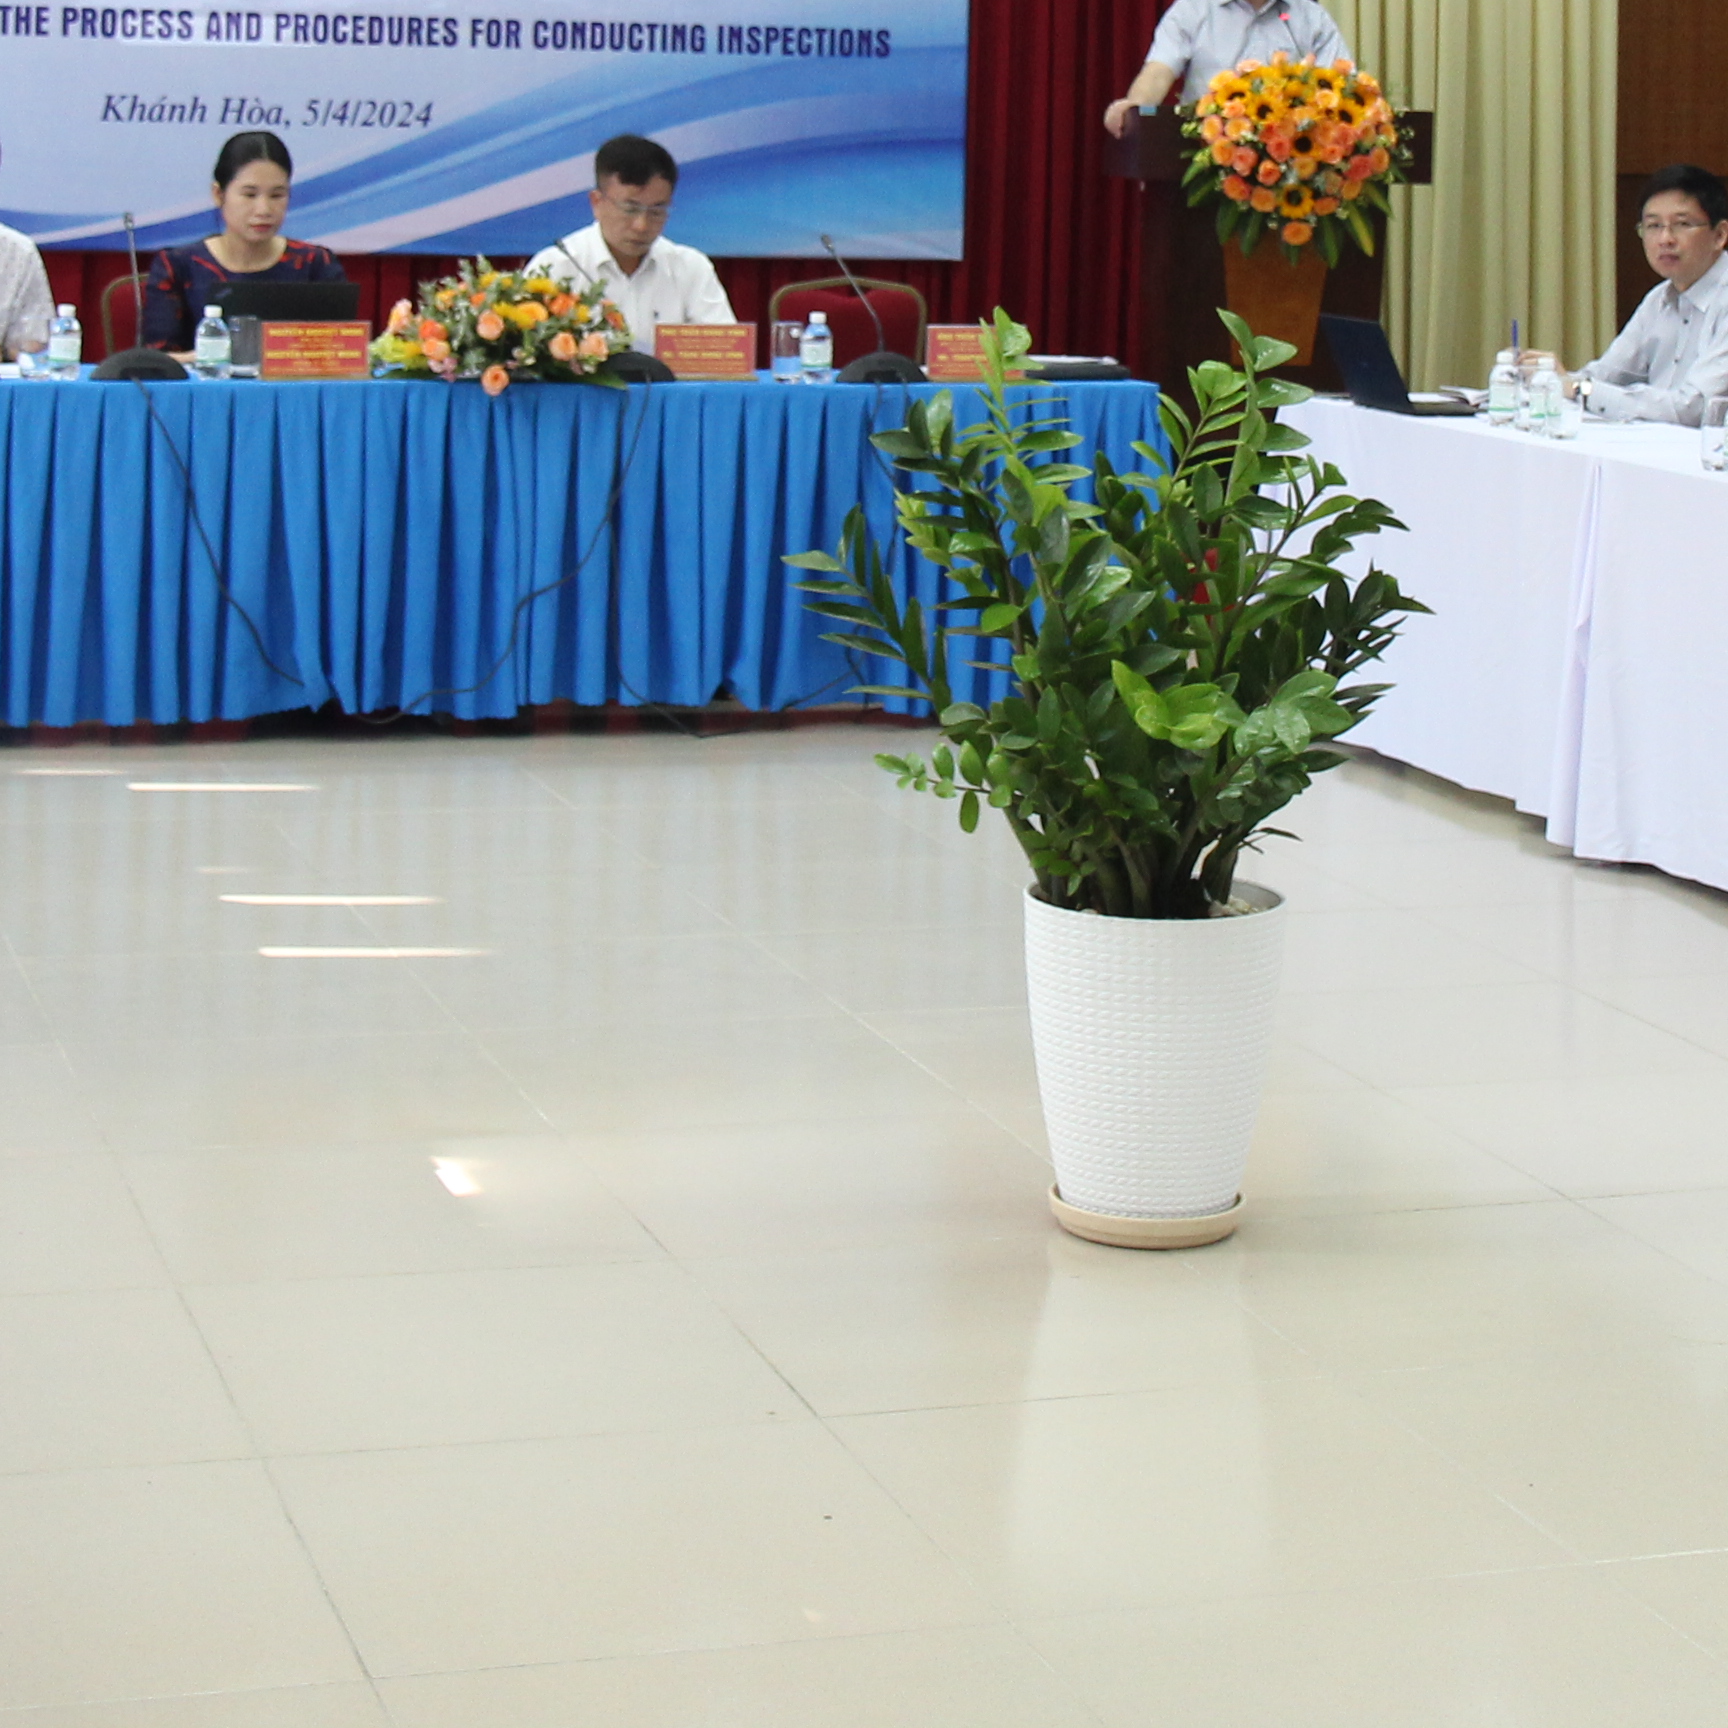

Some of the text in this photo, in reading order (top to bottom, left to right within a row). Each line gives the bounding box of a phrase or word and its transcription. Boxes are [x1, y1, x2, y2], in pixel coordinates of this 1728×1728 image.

[61, 7, 194, 41] PROCESS
[205, 11, 262, 44] AND
[274, 13, 459, 49] PROCEDURES
[470, 19, 521, 50] FOR
[532, 20, 706, 55] CONDUCTING
[717, 25, 892, 59] INSPECTIONS
[100, 93, 208, 126] Khánh
[300, 97, 435, 130] 5/4/2024
